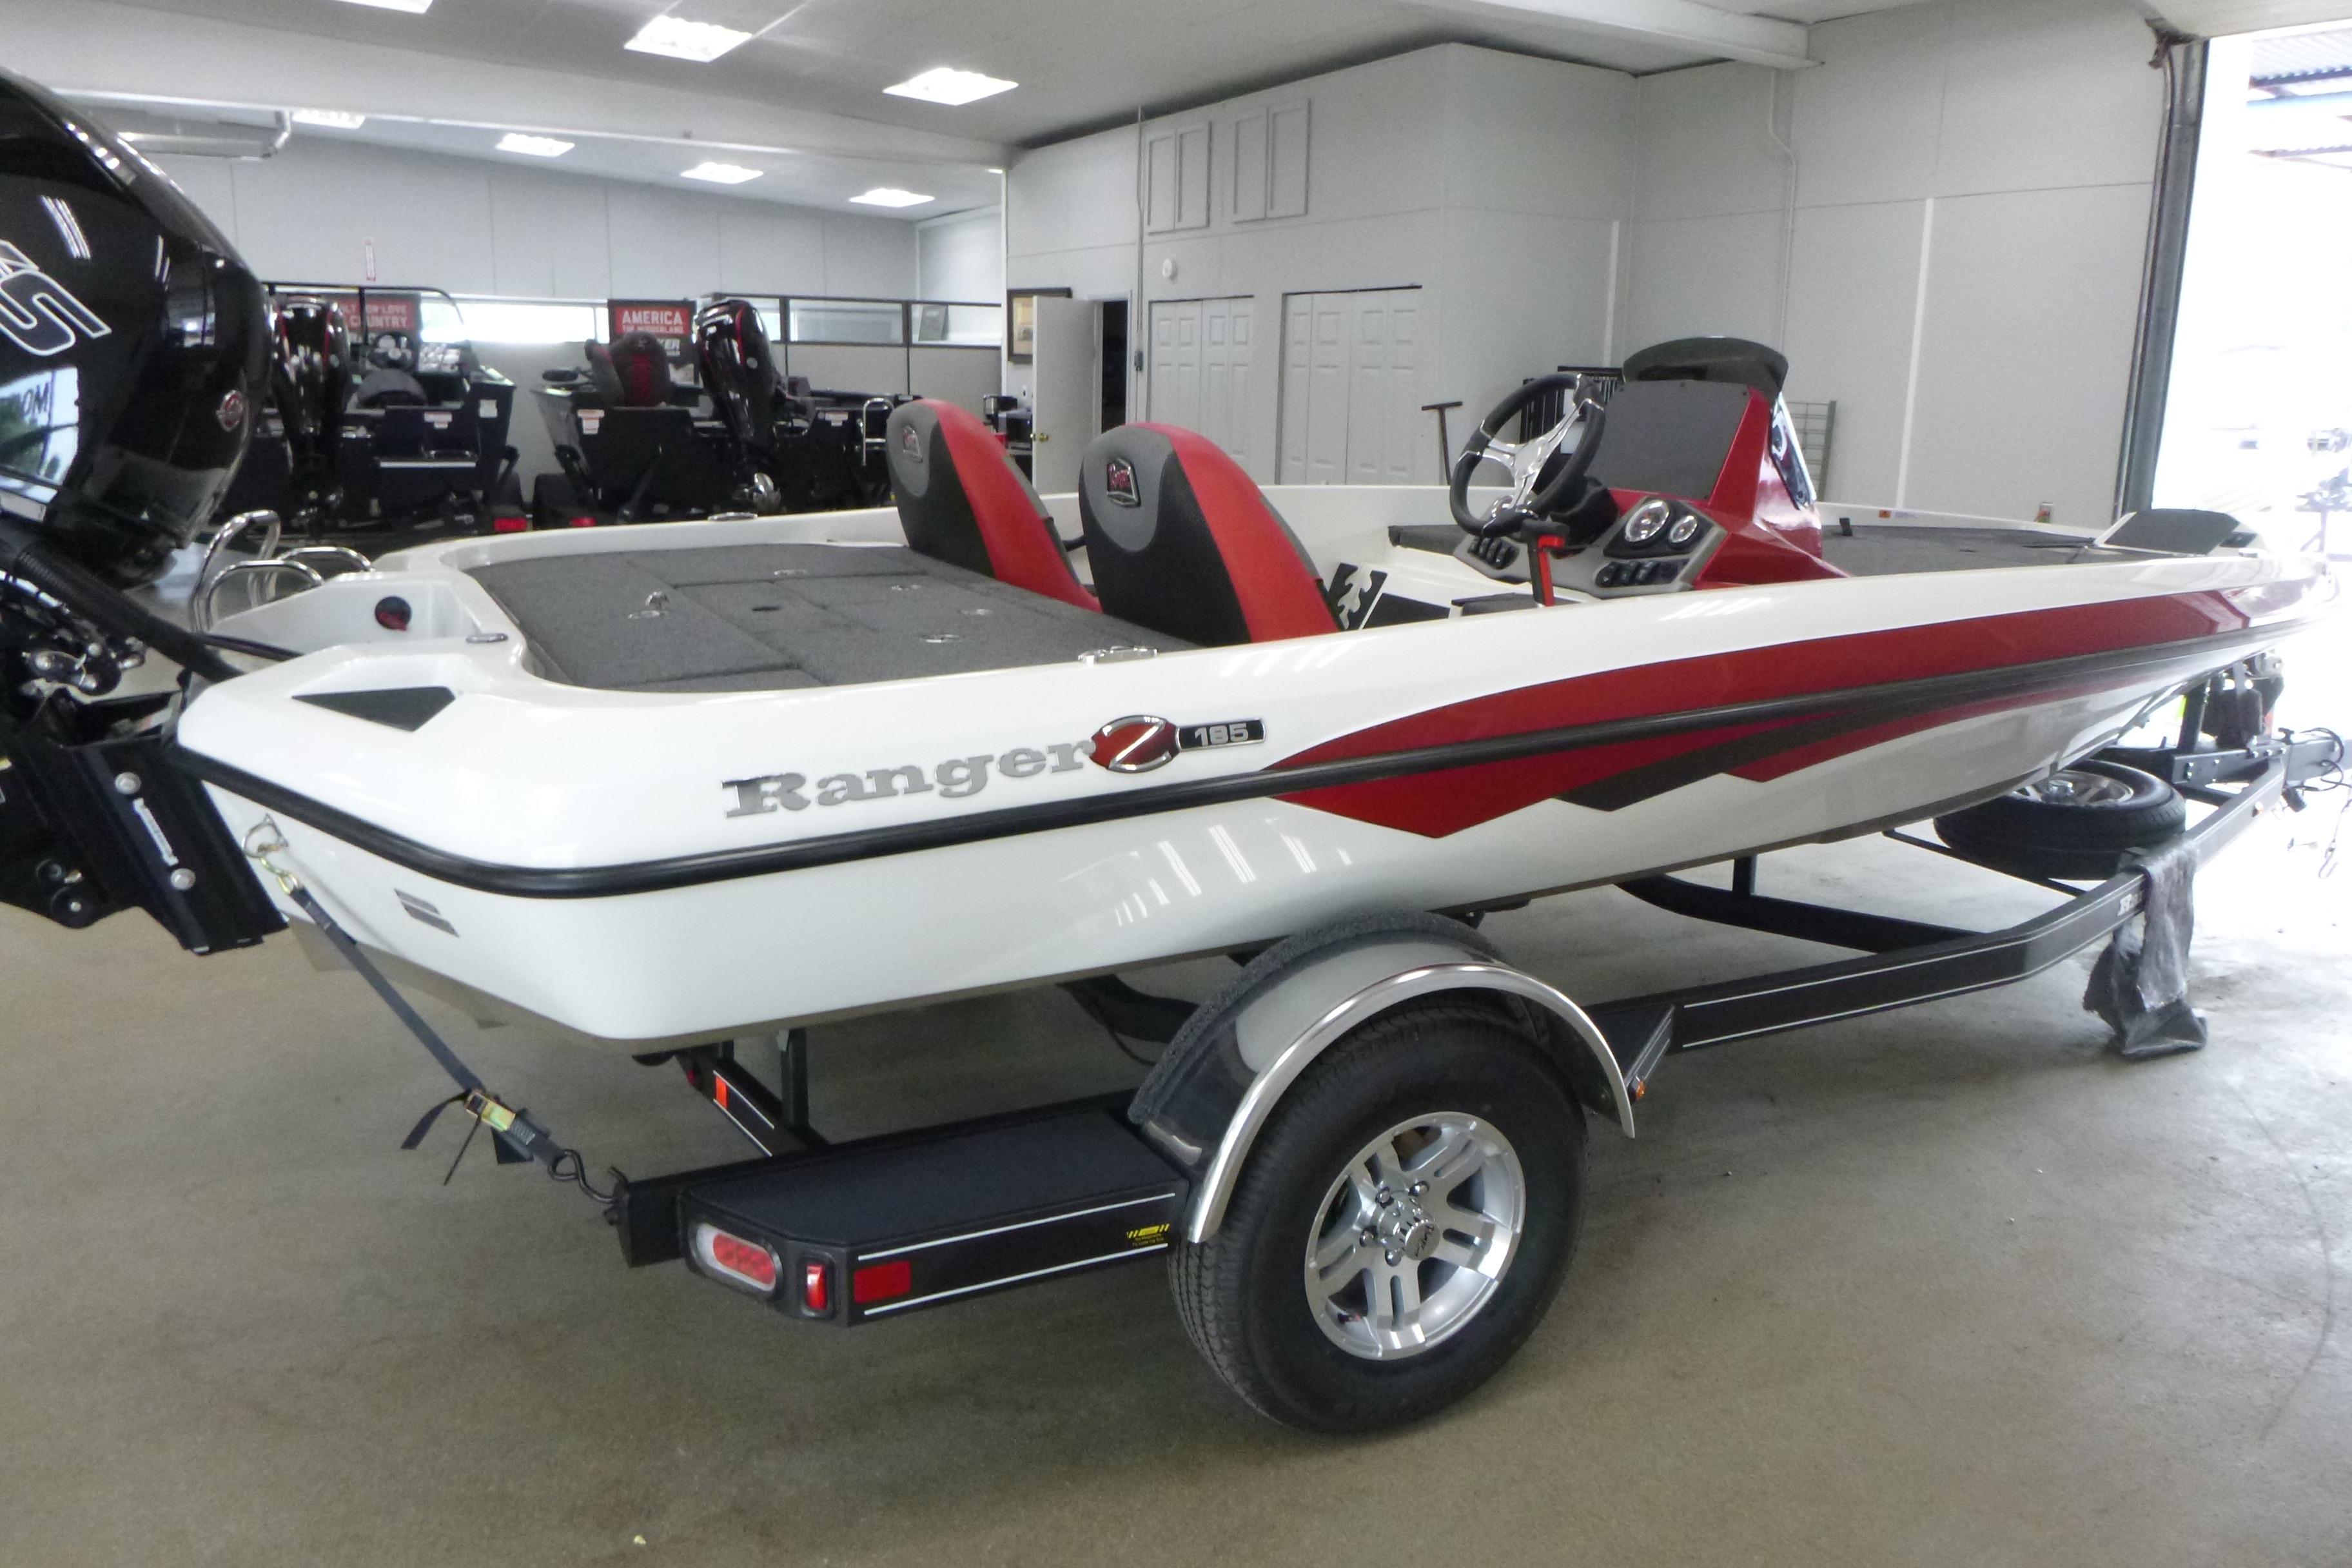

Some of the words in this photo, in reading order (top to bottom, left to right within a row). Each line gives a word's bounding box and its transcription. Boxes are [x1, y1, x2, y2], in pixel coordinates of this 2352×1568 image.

[622, 310, 683, 325] AMERICA
[721, 737, 1095, 819] Ranger
[1194, 723, 1249, 747] 185
